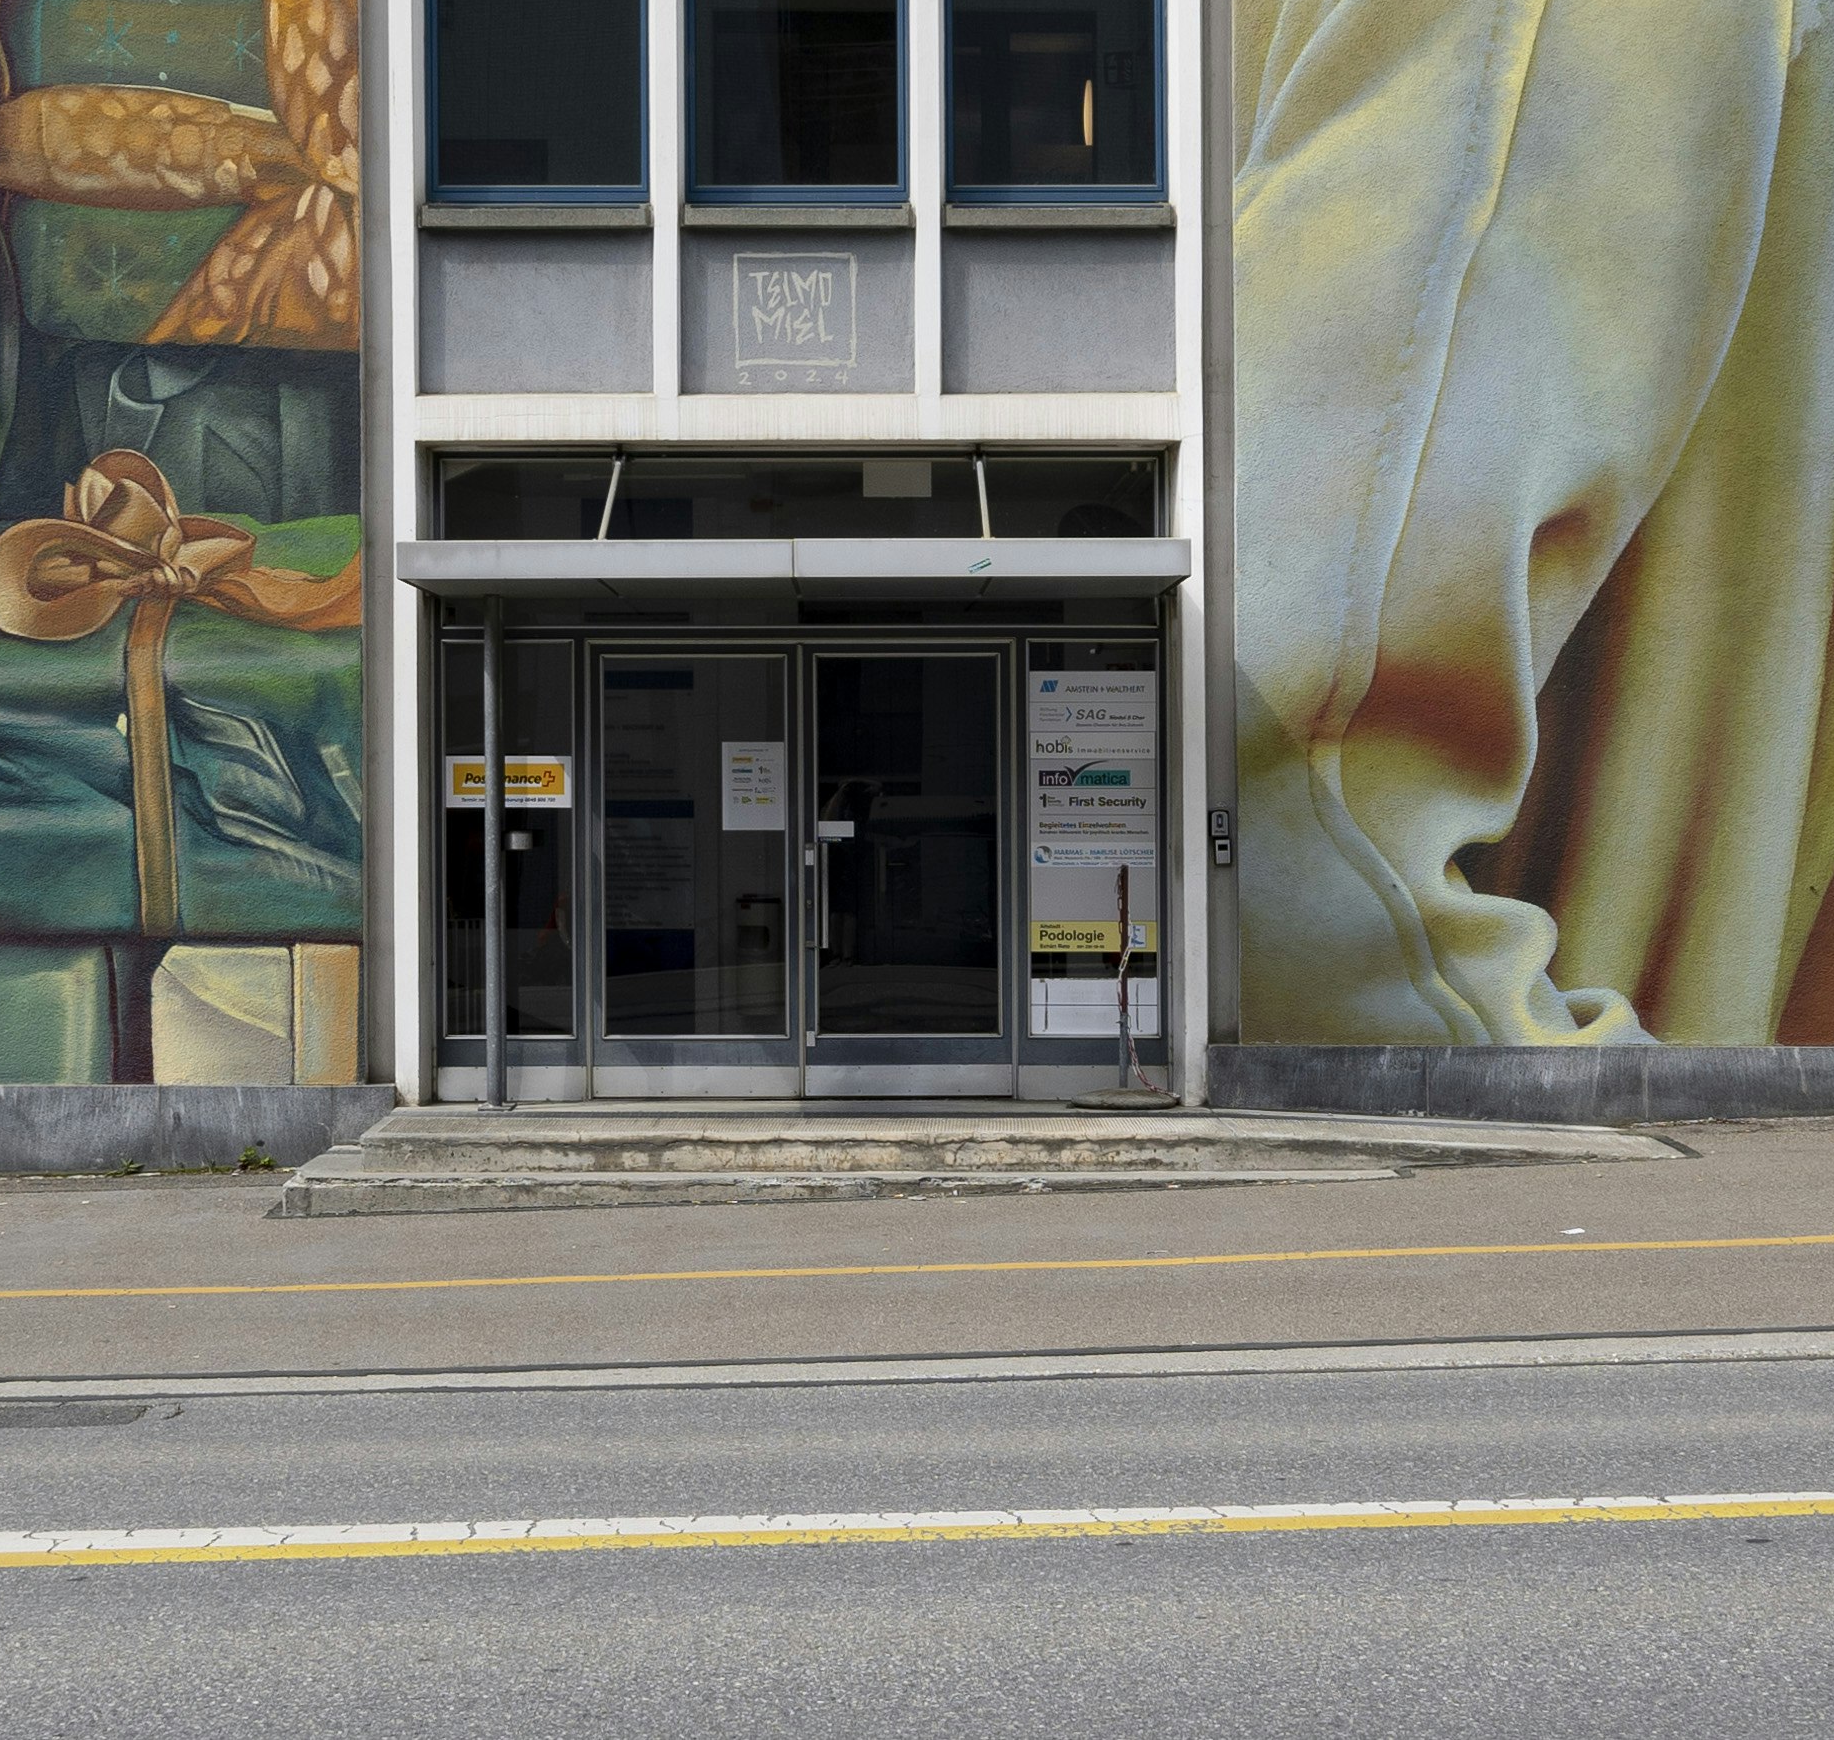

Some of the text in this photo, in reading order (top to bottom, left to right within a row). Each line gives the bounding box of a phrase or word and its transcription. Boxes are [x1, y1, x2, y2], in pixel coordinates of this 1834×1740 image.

[749, 270, 832, 312] TELMO
[752, 305, 833, 345] MIEL
[1065, 685, 1098, 693] AMSTEIN
[1106, 685, 1145, 693] WALTHERT
[1075, 709, 1107, 720] SAG
[1069, 796, 1095, 807] First
[1098, 796, 1147, 809] Security
[1039, 930, 1105, 943] Podologie
